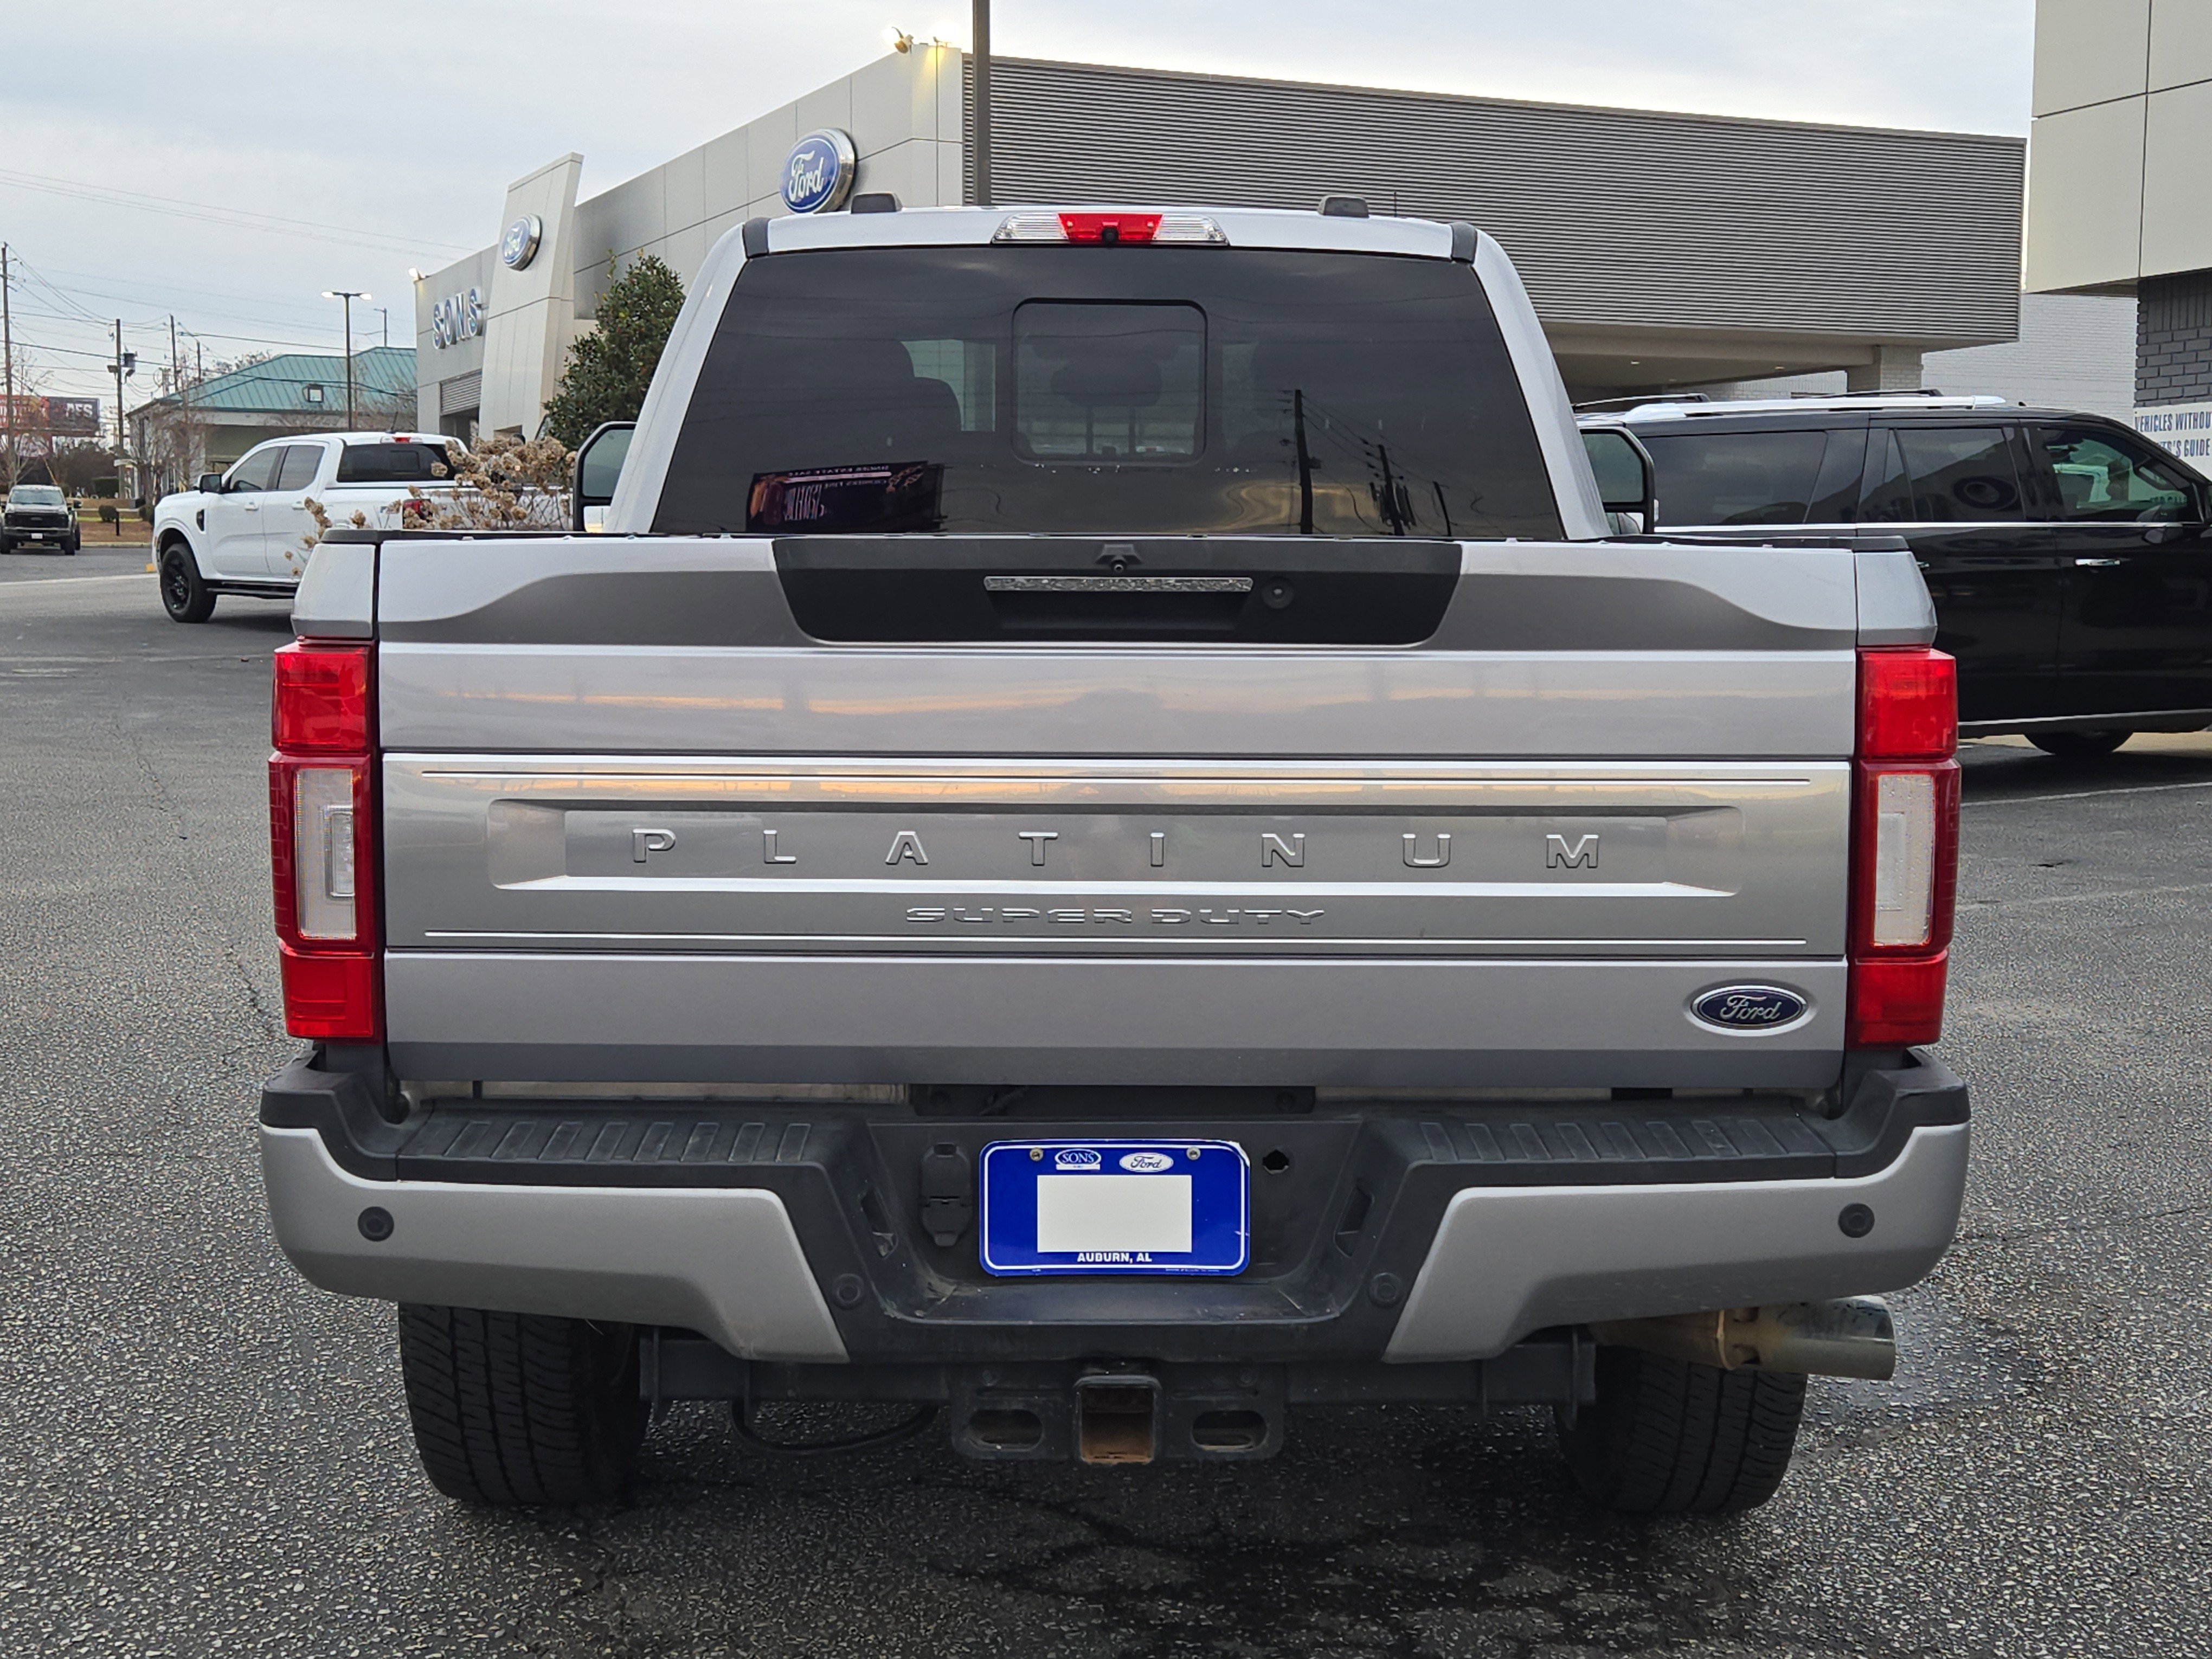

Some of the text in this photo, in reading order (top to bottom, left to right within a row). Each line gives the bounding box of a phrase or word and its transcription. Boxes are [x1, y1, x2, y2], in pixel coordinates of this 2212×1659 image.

[788, 150, 824, 202] Ford
[433, 288, 482, 350] SONS
[2134, 411, 2212, 432] VEHICLES WITHOU
[2184, 438, 2210, 456] GUIDE
[633, 828, 1599, 869] PLATINUM
[906, 906, 1324, 924] SUPER DUTY
[1720, 994, 1782, 1020] Ford
[1062, 1152, 1162, 1169] SONS Ford
[1136, 1252, 1152, 1263] AL
